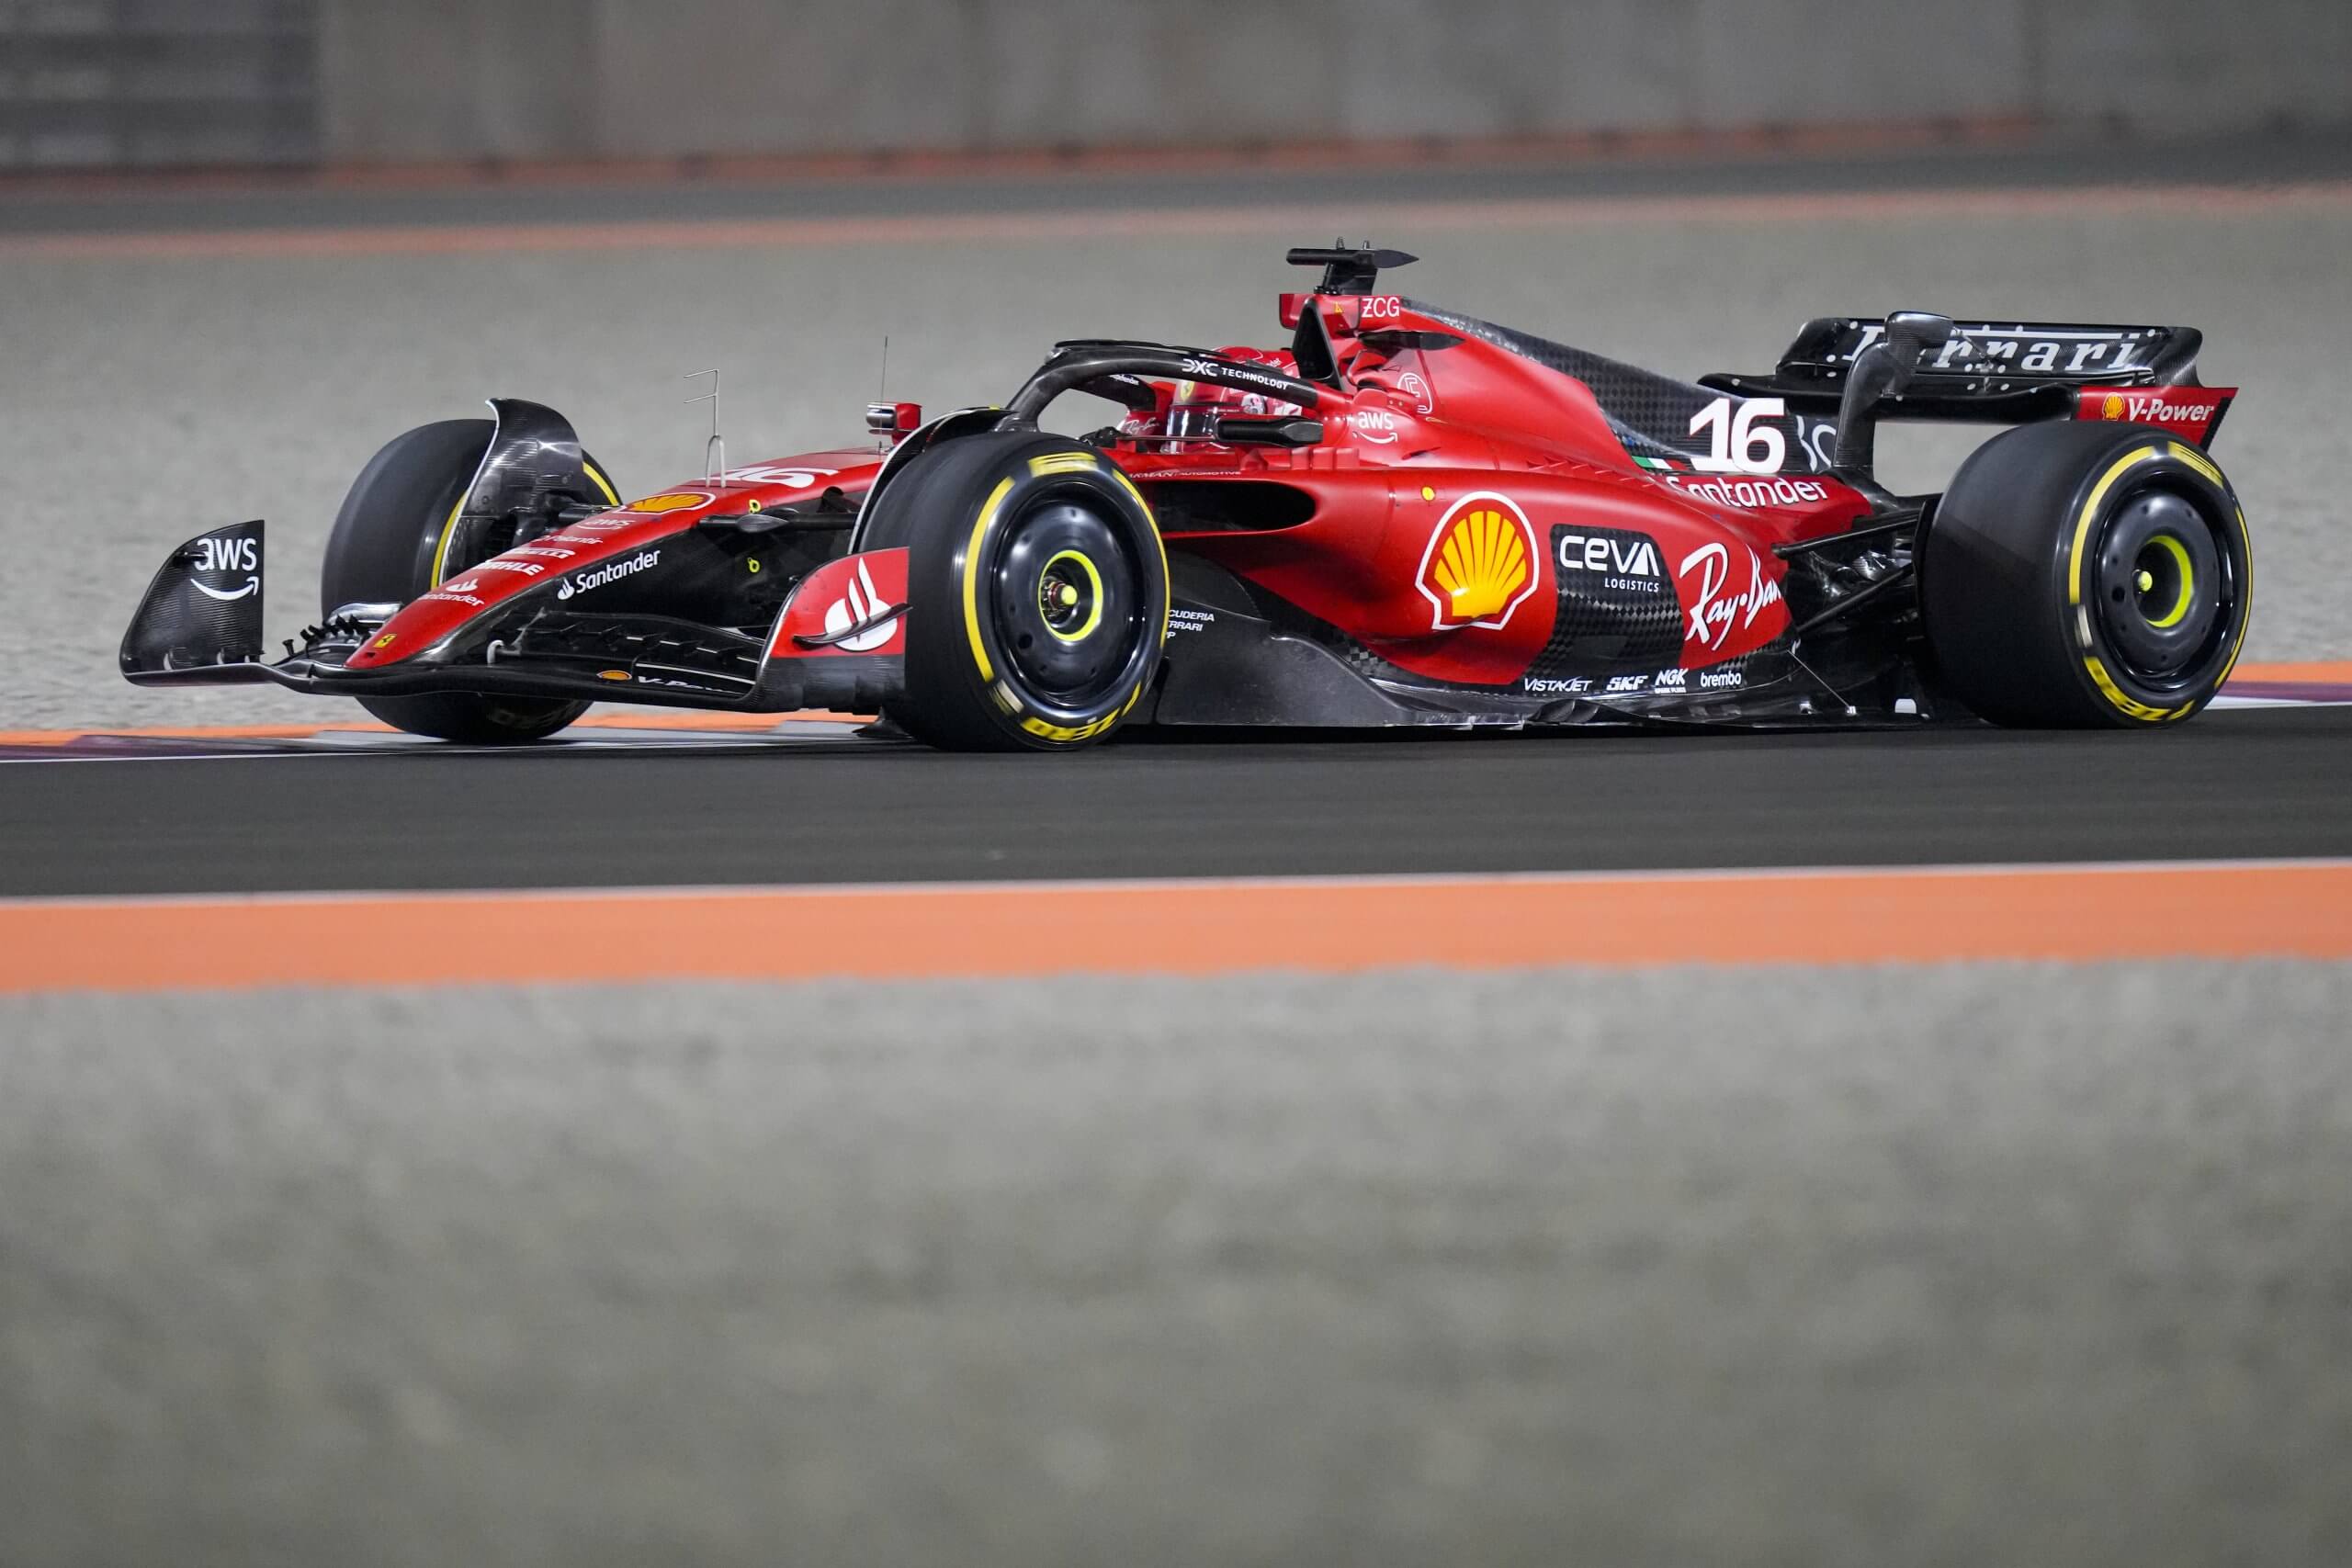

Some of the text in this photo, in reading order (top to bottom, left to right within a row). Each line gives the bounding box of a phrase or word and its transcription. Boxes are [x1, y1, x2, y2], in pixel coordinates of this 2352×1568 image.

[1362, 297, 1400, 318] ZCG
[1221, 367, 1288, 390] TECHNOLOGY
[2128, 397, 2215, 422] V-Power
[1357, 411, 1395, 431] aws
[1689, 397, 1786, 474] 16
[194, 537, 257, 571] aws
[576, 549, 661, 594] Santander
[1604, 577, 1660, 593] LOGISTICS
[1168, 609, 1216, 622] CUDERIA
[1168, 620, 1204, 632] RRARI
[1606, 674, 1649, 691] SKF
[1654, 667, 1690, 686] NGK
[1700, 671, 1742, 688] brembo
